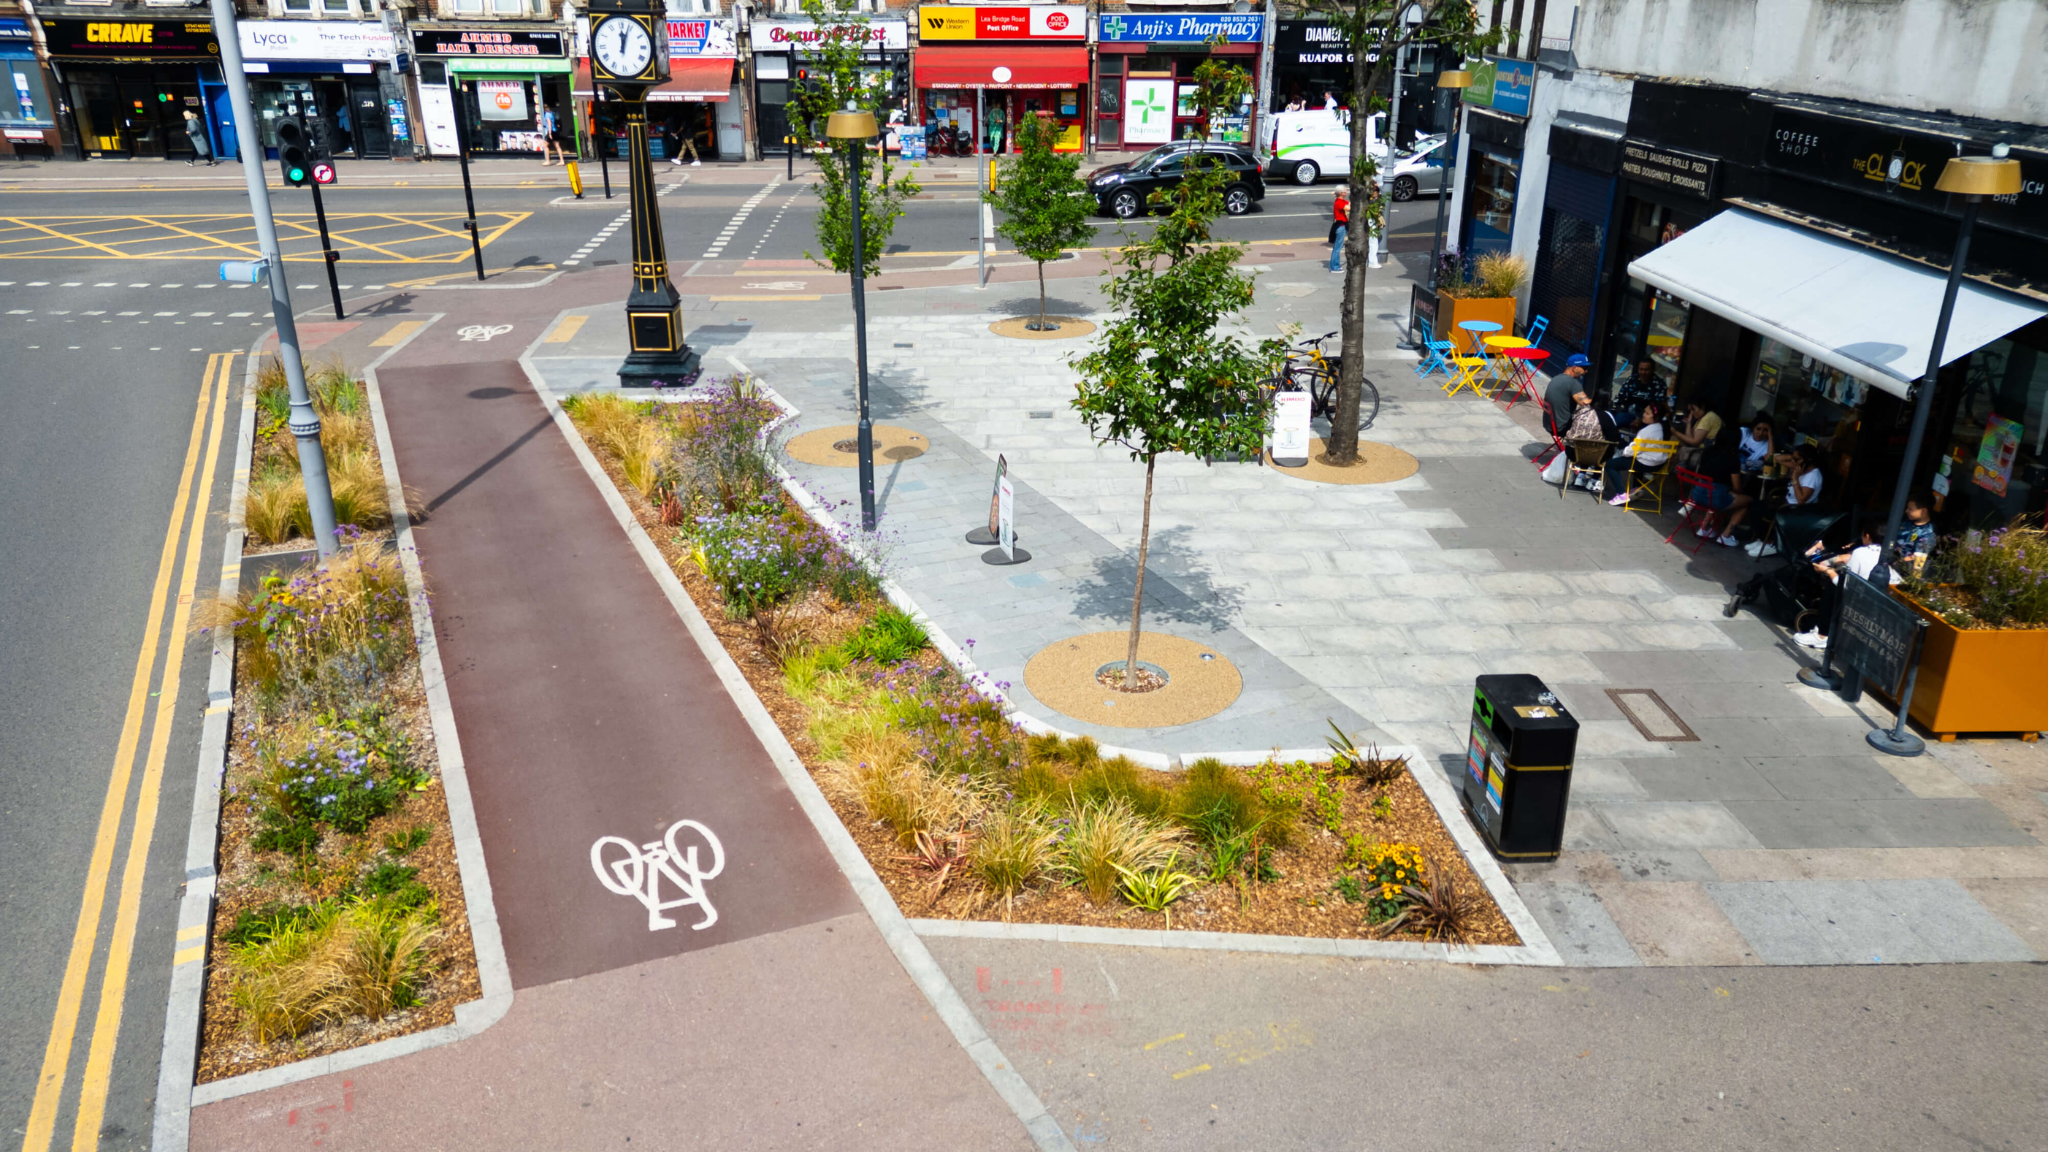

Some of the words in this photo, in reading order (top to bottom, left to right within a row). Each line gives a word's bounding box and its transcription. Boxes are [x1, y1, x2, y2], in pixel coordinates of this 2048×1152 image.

[86, 23, 154, 43] CRRAVE
[1131, 20, 1174, 40] Anji's
[1178, 18, 1260, 40] Pharmacy
[253, 32, 287, 46] Lyca
[461, 33, 512, 43] AHMED
[436, 43, 471, 53] HAIR
[475, 44, 539, 54] DRESSER
[1299, 53, 1343, 62] KUAFOR
[1775, 129, 1819, 147] COFFEE
[1779, 142, 1809, 156] SHOP
[1625, 147, 1648, 160] PRETZELS
[1649, 152, 1672, 166] SAUSAGE
[1672, 157, 1689, 170] ROLLS
[1692, 162, 1707, 174] PIZZA
[1853, 158, 1866, 172] THE
[1623, 162, 1641, 174] PASTIES
[1642, 166, 1671, 182] DOUGHNUTS
[1672, 174, 1706, 191] CROISSANTS
[1843, 605, 1882, 636] FRESHLY
